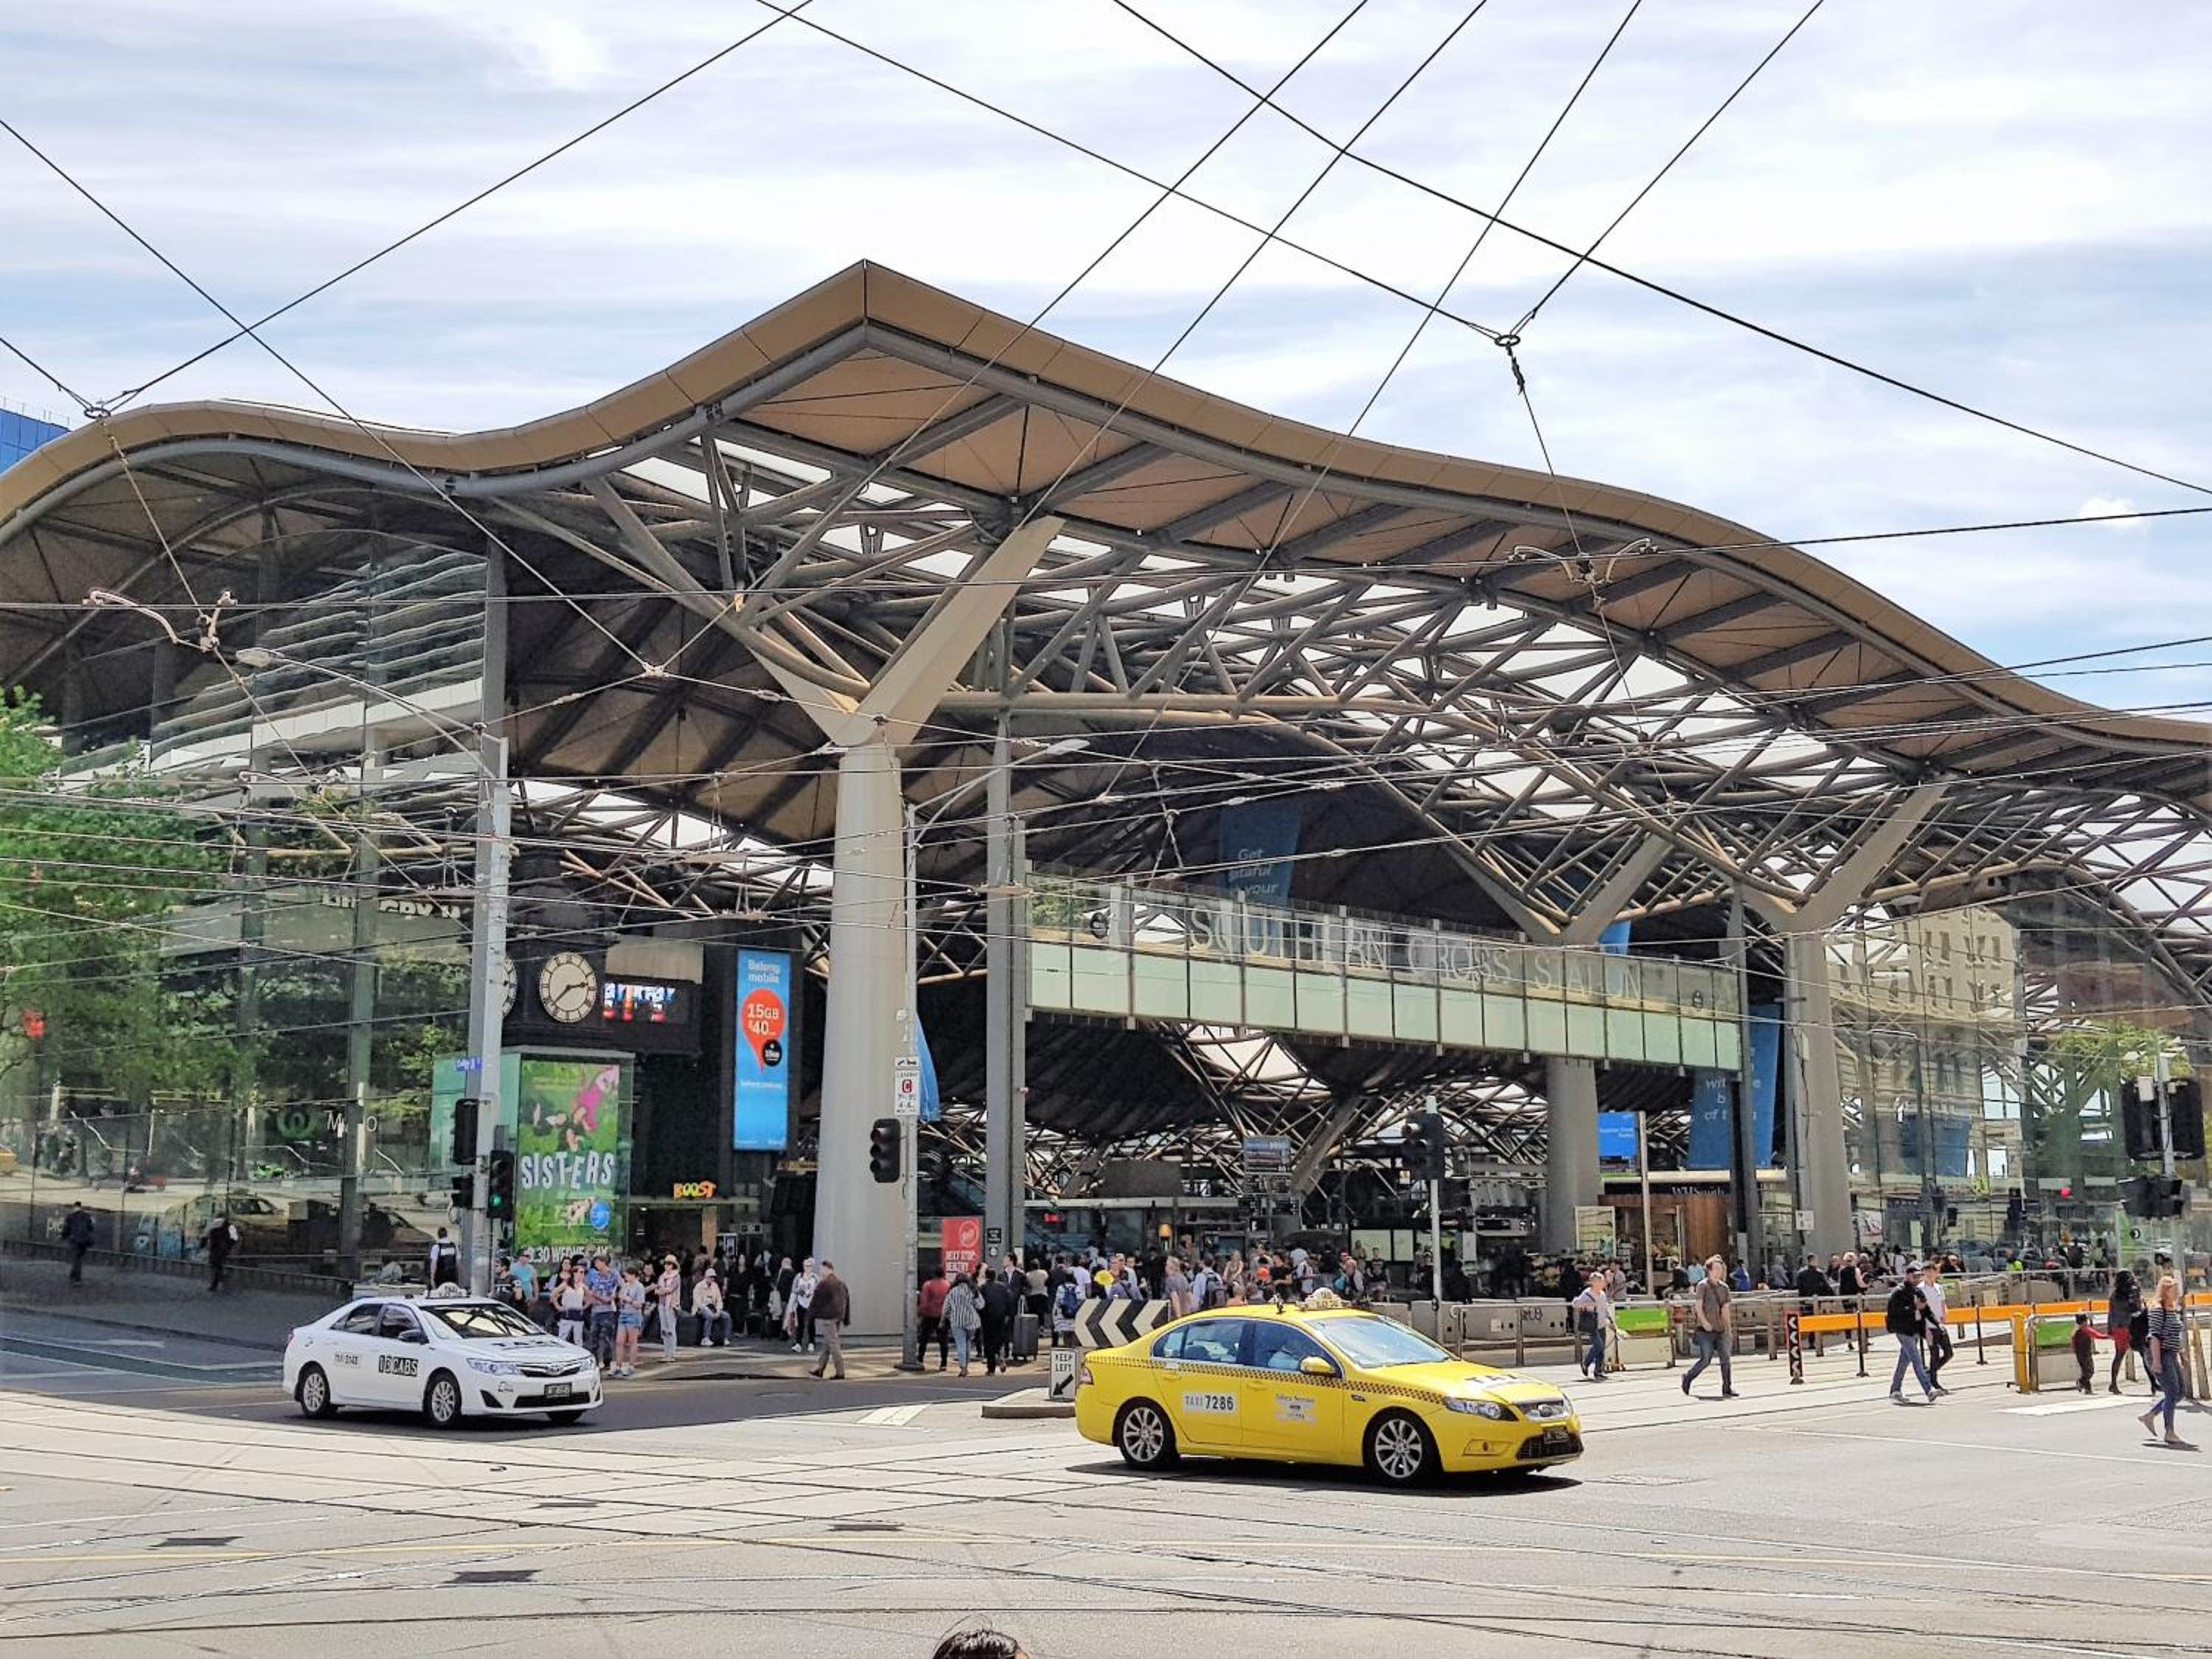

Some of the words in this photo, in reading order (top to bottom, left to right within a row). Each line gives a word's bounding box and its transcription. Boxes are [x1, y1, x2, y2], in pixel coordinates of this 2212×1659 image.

[1534, 952, 1641, 999] STATON
[747, 1003, 779, 1020] 15GB
[521, 1150, 614, 1190] SISTERS
[673, 1180, 717, 1200] BOOST
[552, 1246, 608, 1263] WEDNEAY
[1055, 1354, 1072, 1362] KEEP
[1055, 1363, 1072, 1372] LEFT
[1204, 1394, 1234, 1411] 7286
